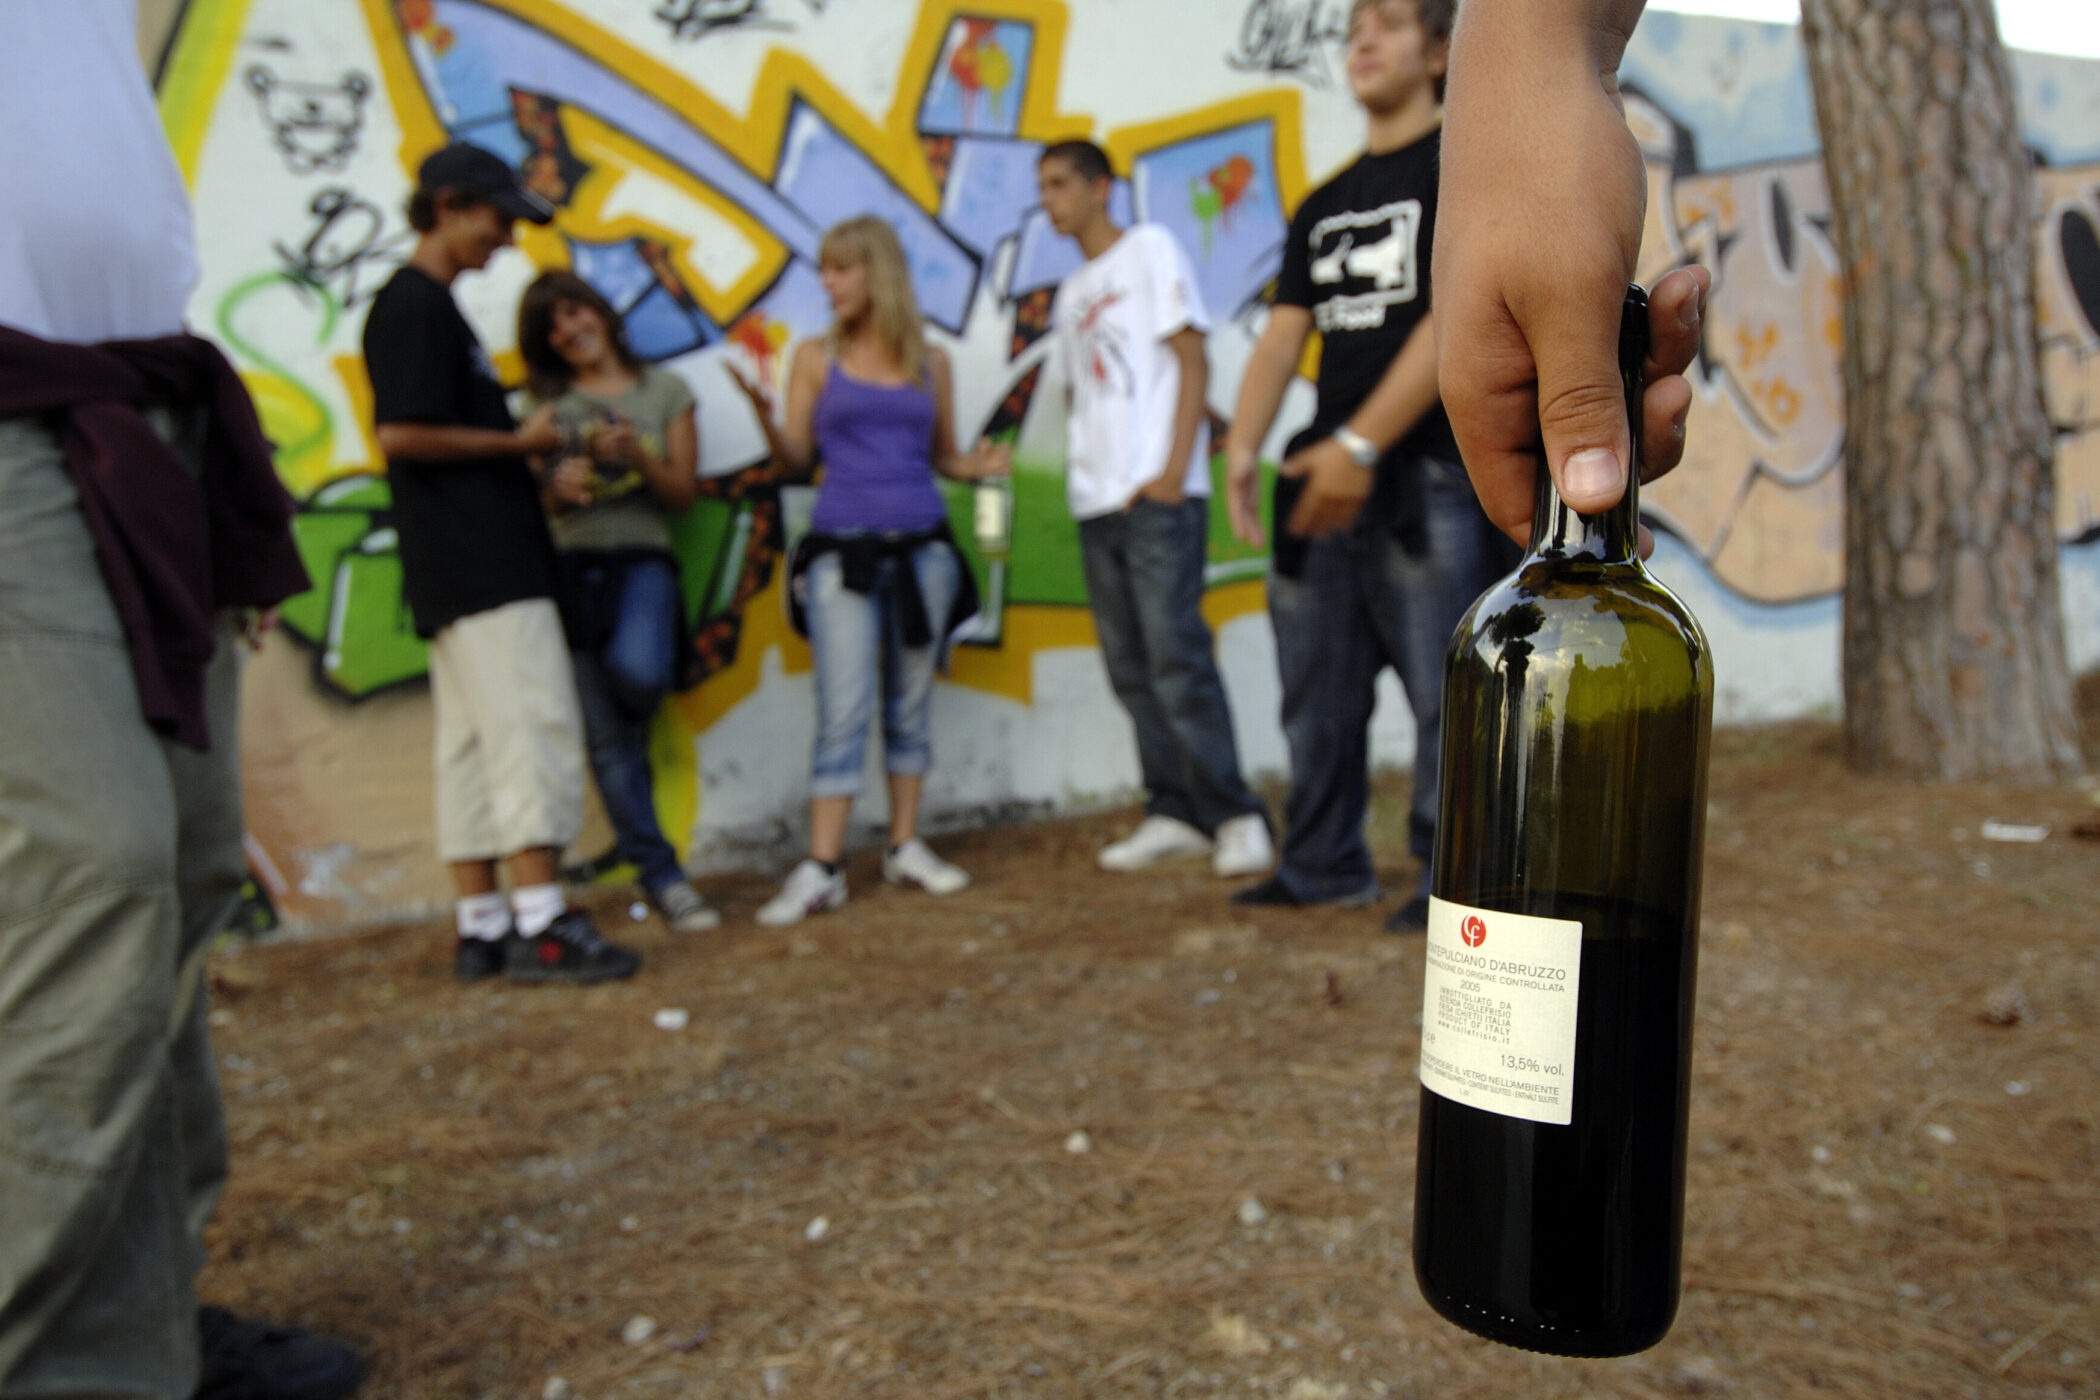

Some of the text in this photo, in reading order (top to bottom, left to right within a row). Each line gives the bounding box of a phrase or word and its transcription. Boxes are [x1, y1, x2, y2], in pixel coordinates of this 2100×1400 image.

[1428, 942, 1566, 981] ONTEPULCIANO D'ABRUZZO
[1460, 979, 1481, 993] 2005
[1465, 969, 1497, 983] ORIGINE
[1500, 976, 1565, 993] CONTROLLATA
[1440, 986, 1512, 1011] IMBOTTIGLIATO DA
[1463, 1001, 1511, 1019] COLLEFRISIO
[1438, 1009, 1511, 1036] PRODUCT OF ITALY
[1485, 1015, 1511, 1027] ITALIA
[1500, 1053, 1565, 1076] 13,5% vol.
[1462, 1068, 1487, 1082] VETRO
[1488, 1075, 1560, 1096] NELL'AMBIENTE
